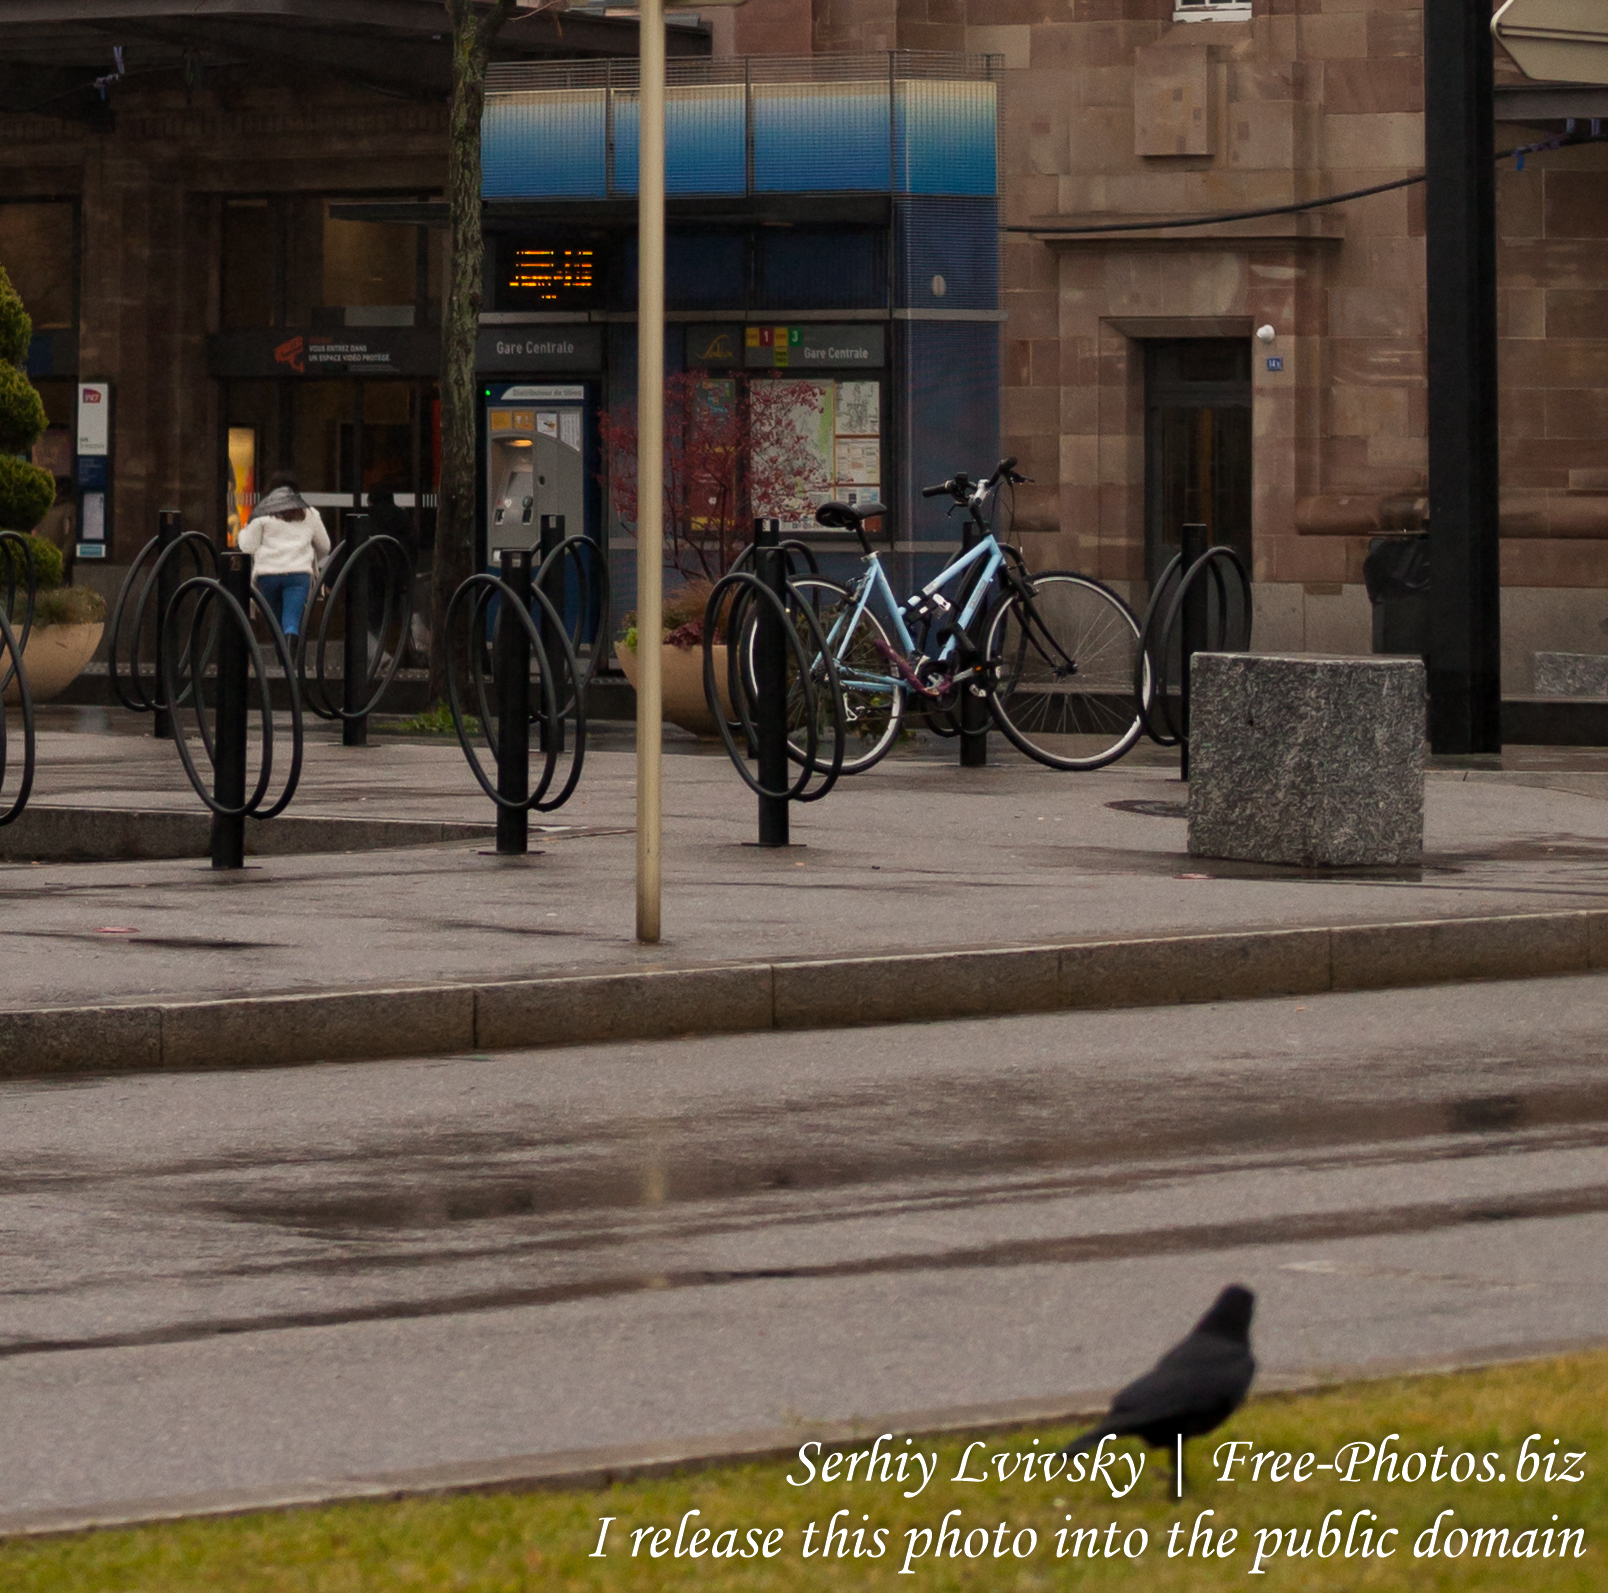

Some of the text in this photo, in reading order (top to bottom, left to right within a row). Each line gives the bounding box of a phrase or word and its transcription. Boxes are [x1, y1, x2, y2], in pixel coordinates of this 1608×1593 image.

[496, 340, 574, 355] Gare Centrale
[804, 346, 869, 360] Gare Centrale
